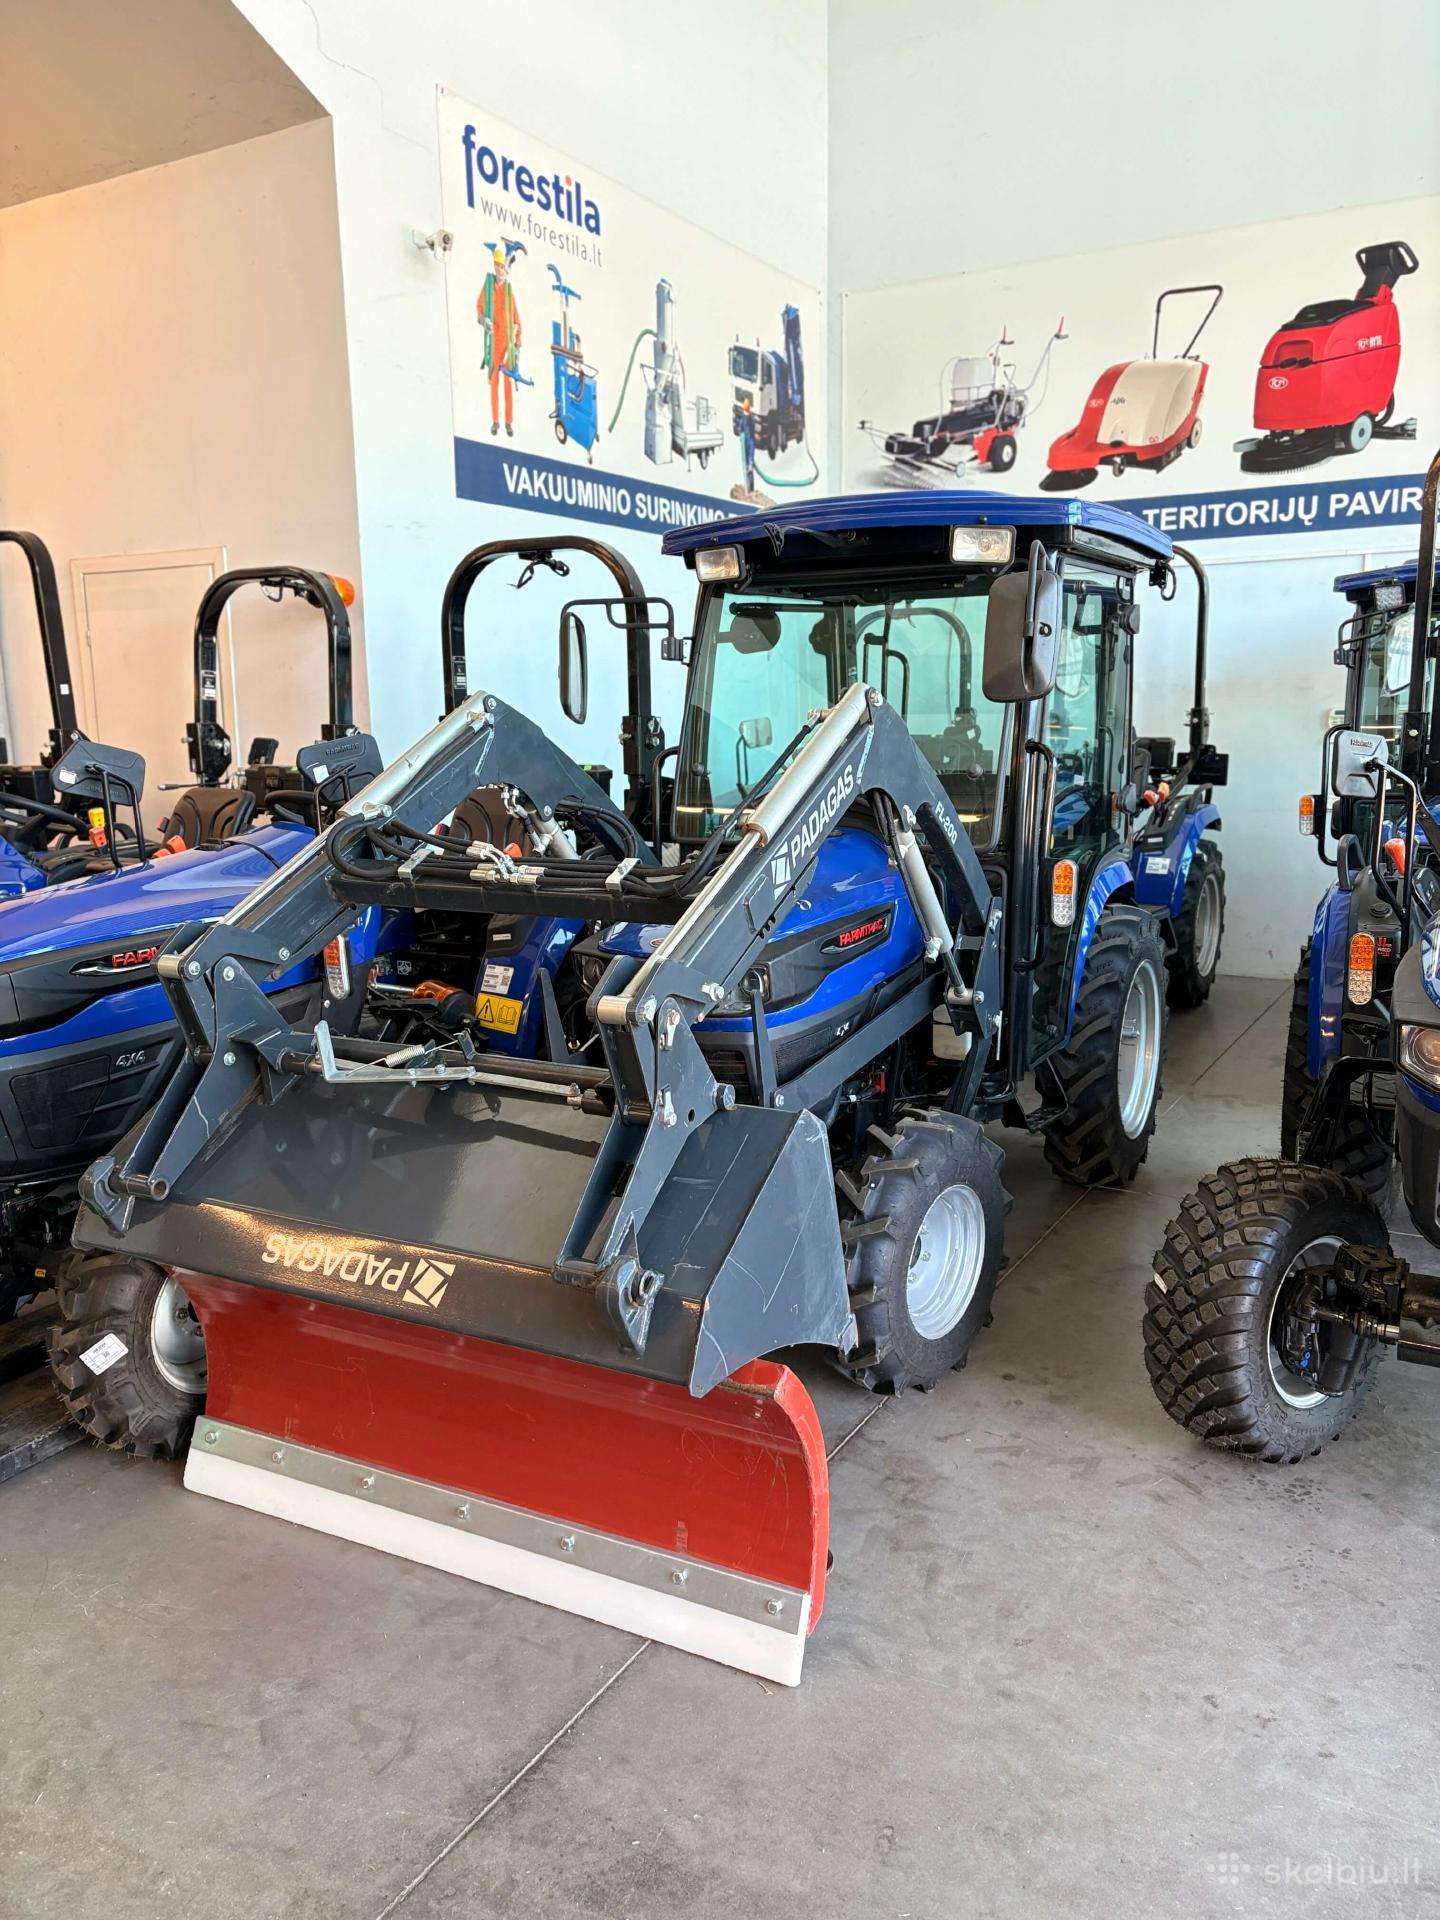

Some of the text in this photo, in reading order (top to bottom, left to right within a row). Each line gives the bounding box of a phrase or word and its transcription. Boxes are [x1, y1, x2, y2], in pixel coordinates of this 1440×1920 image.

[462, 124, 601, 236] forestila
[480, 196, 603, 268] www.forestila.lt
[502, 463, 631, 516] VAKUUMINIO
[1142, 494, 1319, 531] TERITORIJŲ
[791, 764, 855, 869] PADAGAS
[934, 801, 958, 846] FL-200
[261, 1233, 410, 1292] PADAGAS
